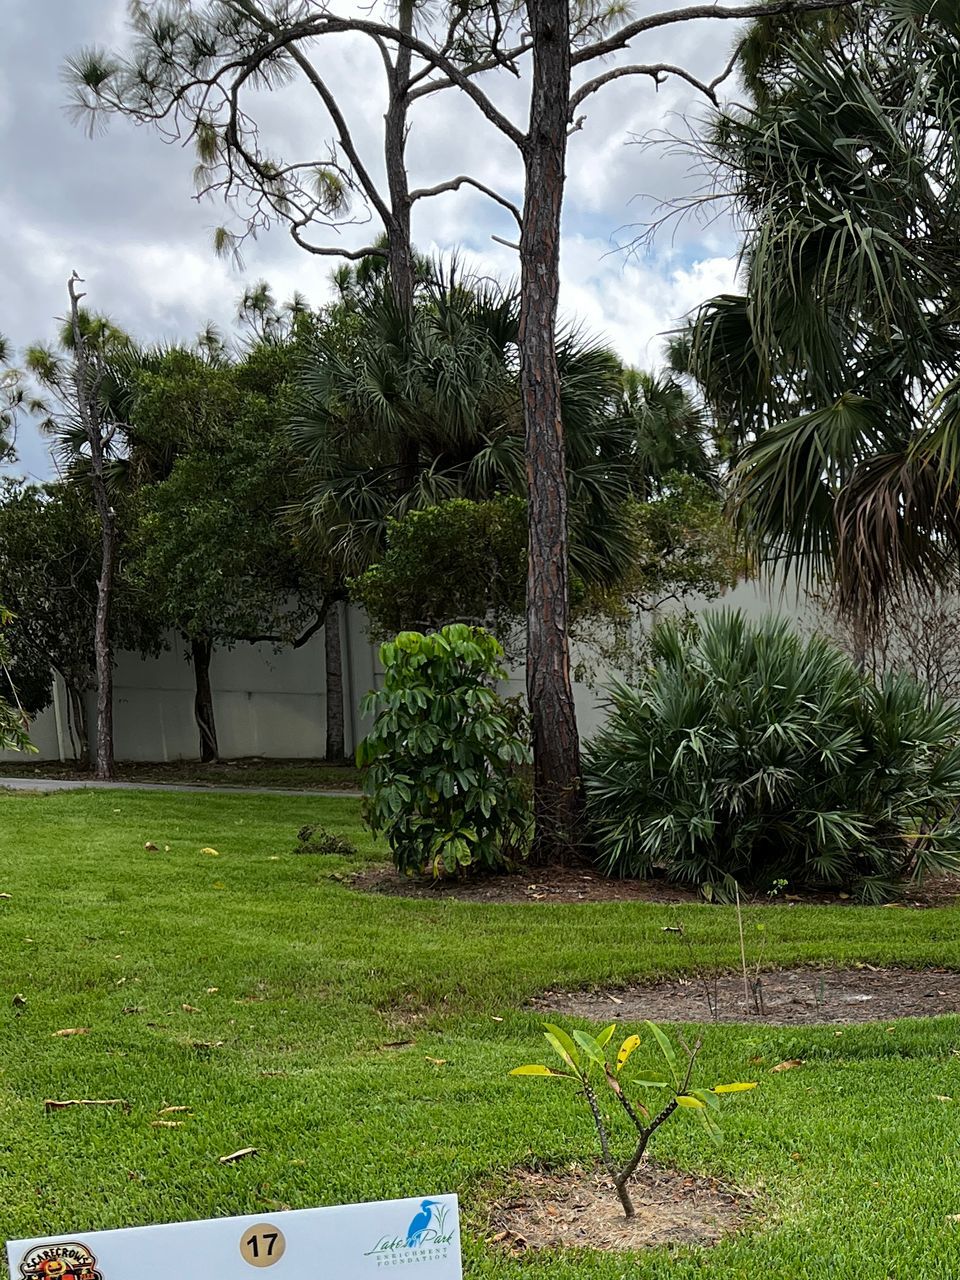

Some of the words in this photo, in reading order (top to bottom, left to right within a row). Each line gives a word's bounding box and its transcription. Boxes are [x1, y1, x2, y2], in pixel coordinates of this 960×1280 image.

[246, 1232, 278, 1258] 17
[411, 1228, 455, 1247] Park
[26, 1247, 90, 1269] SCARECROWS
[376, 1247, 448, 1261] ENRICHMENT
[377, 1253, 448, 1267] FOUNDATION
